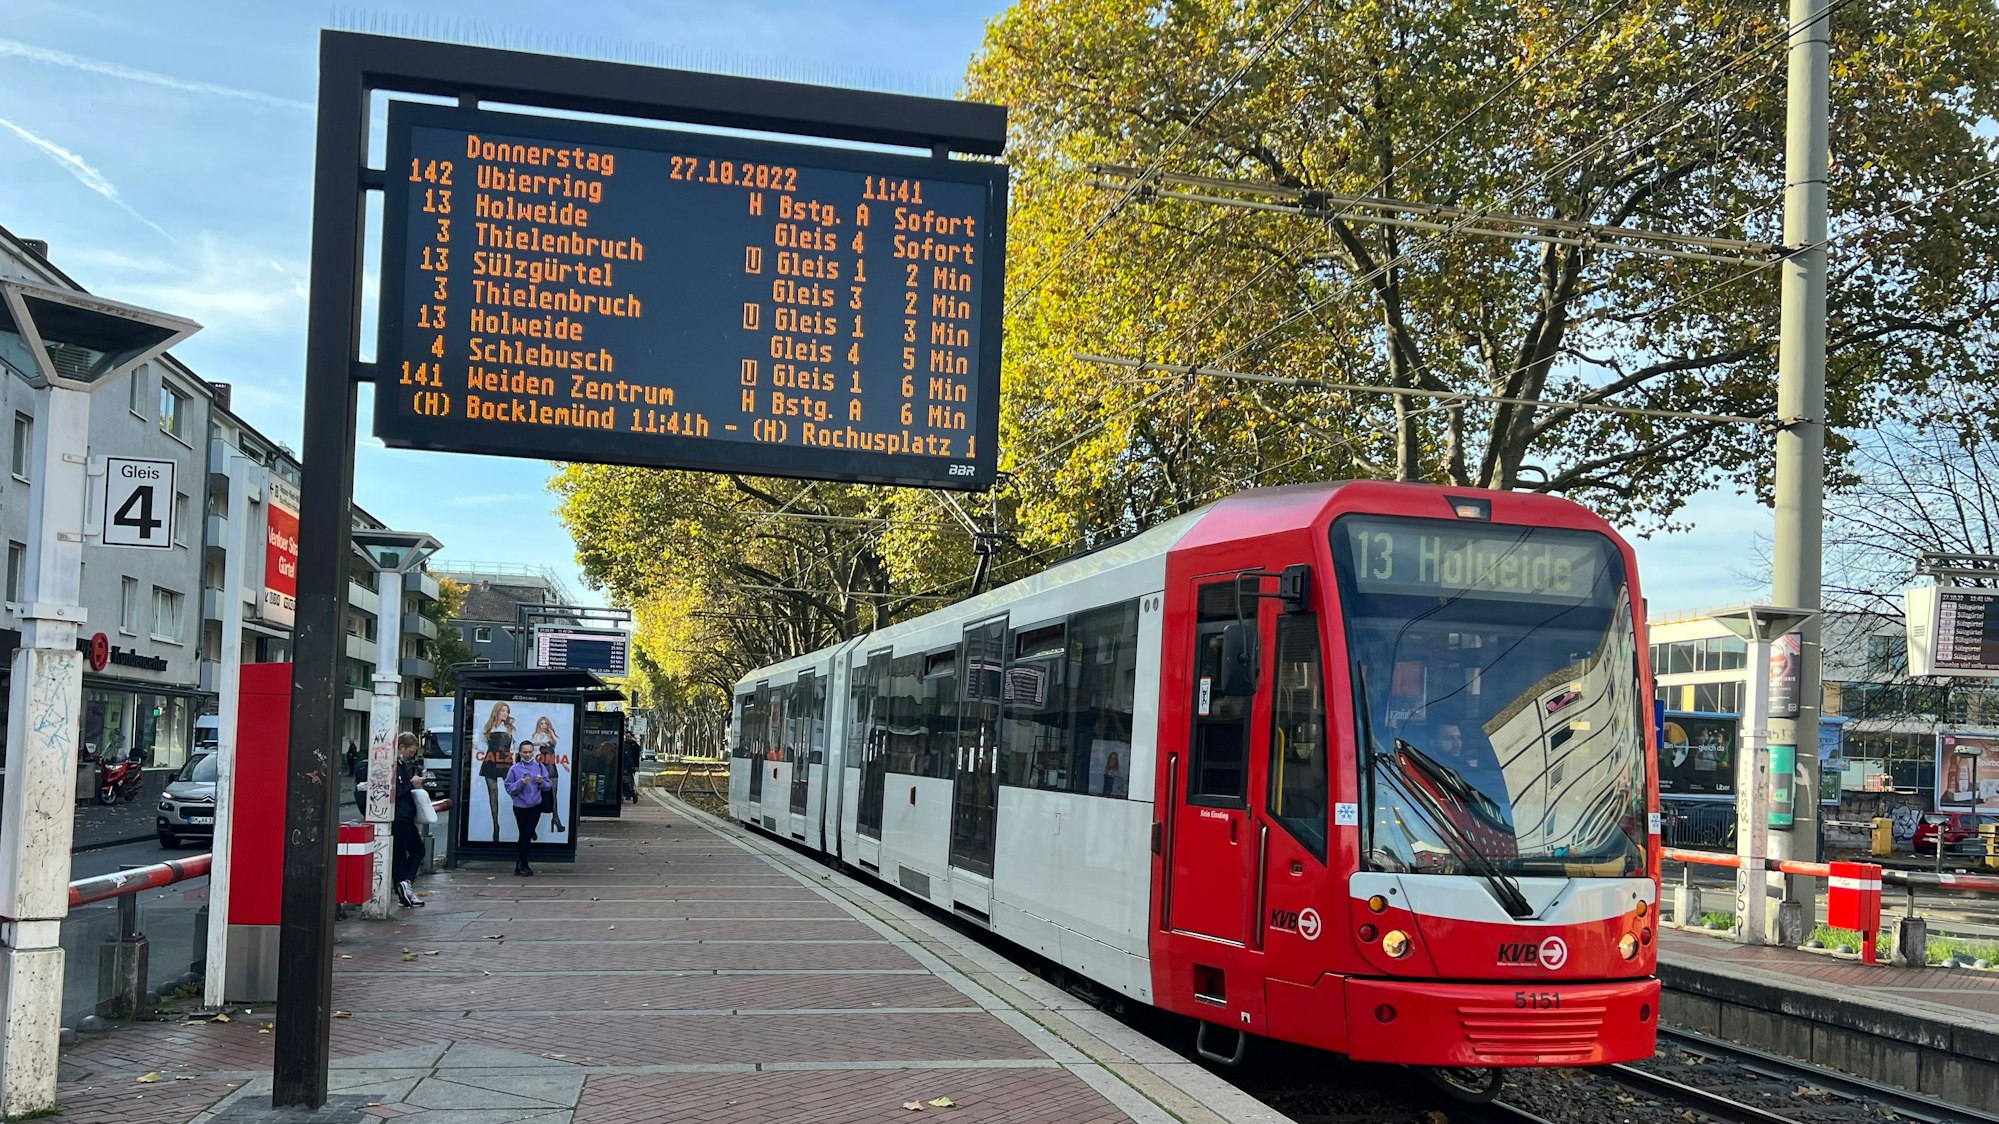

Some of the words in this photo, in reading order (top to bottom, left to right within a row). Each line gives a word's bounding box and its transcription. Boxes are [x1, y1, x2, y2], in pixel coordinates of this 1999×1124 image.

[409, 159, 453, 185] 142
[477, 165, 602, 204] Ubierring
[749, 192, 763, 215] H
[779, 195, 841, 227] Bstg.
[856, 203, 869, 226] A
[895, 207, 975, 238] Sofort
[467, 135, 614, 176] Donnerstag
[670, 156, 797, 191] 27.10.2022
[863, 176, 922, 204] 11:41
[423, 188, 452, 214] 13
[476, 194, 588, 227] Holweide
[775, 223, 837, 251] Gleis
[852, 232, 864, 253] 4
[894, 234, 974, 265] Sofort
[437, 218, 451, 243] 3
[476, 222, 644, 261] Thielenbruch
[777, 251, 839, 280] Gleis
[854, 259, 866, 283] 1
[906, 264, 919, 287] 2
[933, 267, 971, 292] Min
[421, 247, 449, 272] 13
[473, 251, 613, 287] Sülzgürtel
[773, 279, 834, 307] Gleis
[850, 286, 862, 310] 3
[905, 291, 918, 315] 2
[932, 295, 970, 319] Min
[434, 276, 448, 301] 3
[473, 279, 641, 318] Thielenbruch
[775, 307, 837, 335] Gleis
[852, 315, 864, 338] 1
[904, 319, 916, 343] 3
[931, 322, 969, 347] Min
[418, 304, 446, 330] 13
[471, 309, 583, 341] Holweide
[771, 335, 832, 363] Gleis
[848, 343, 859, 365] 4
[903, 347, 915, 371] 5
[930, 350, 968, 375] Min
[431, 334, 445, 358] 4
[469, 337, 613, 372] Schlebusch
[773, 364, 835, 391] Gleis
[851, 371, 862, 394] 1
[902, 375, 914, 398] 6
[929, 377, 967, 402] Min
[399, 361, 443, 387] 141
[467, 366, 555, 396] Weiden
[571, 374, 674, 405] Zentrum
[742, 389, 755, 412] H
[772, 391, 833, 422] Bstg.
[849, 398, 862, 421] A
[901, 403, 913, 426] 6
[928, 405, 966, 430] Min
[413, 391, 450, 417] (H)
[466, 394, 615, 430] Bocklemünd
[631, 409, 710, 438] 11:41h
[753, 419, 788, 443] (H)
[803, 422, 951, 457] Rochusplatz
[966, 436, 976, 459] 1
[121, 464, 160, 480] Gleis
[948, 464, 976, 476] BBR
[113, 485, 162, 539] 4
[267, 525, 289, 551] Venloer
[278, 555, 295, 578] Gürtel
[1357, 530, 1394, 580] 13
[1418, 535, 1573, 592] Holweide
[110, 645, 168, 672] Kundencenter
[475, 751, 570, 765] CALZONIA
[1715, 783, 1731, 791] Uber
[1271, 909, 1299, 930] KVB
[1497, 943, 1539, 963] KVB
[1514, 991, 1561, 1010] 5151
